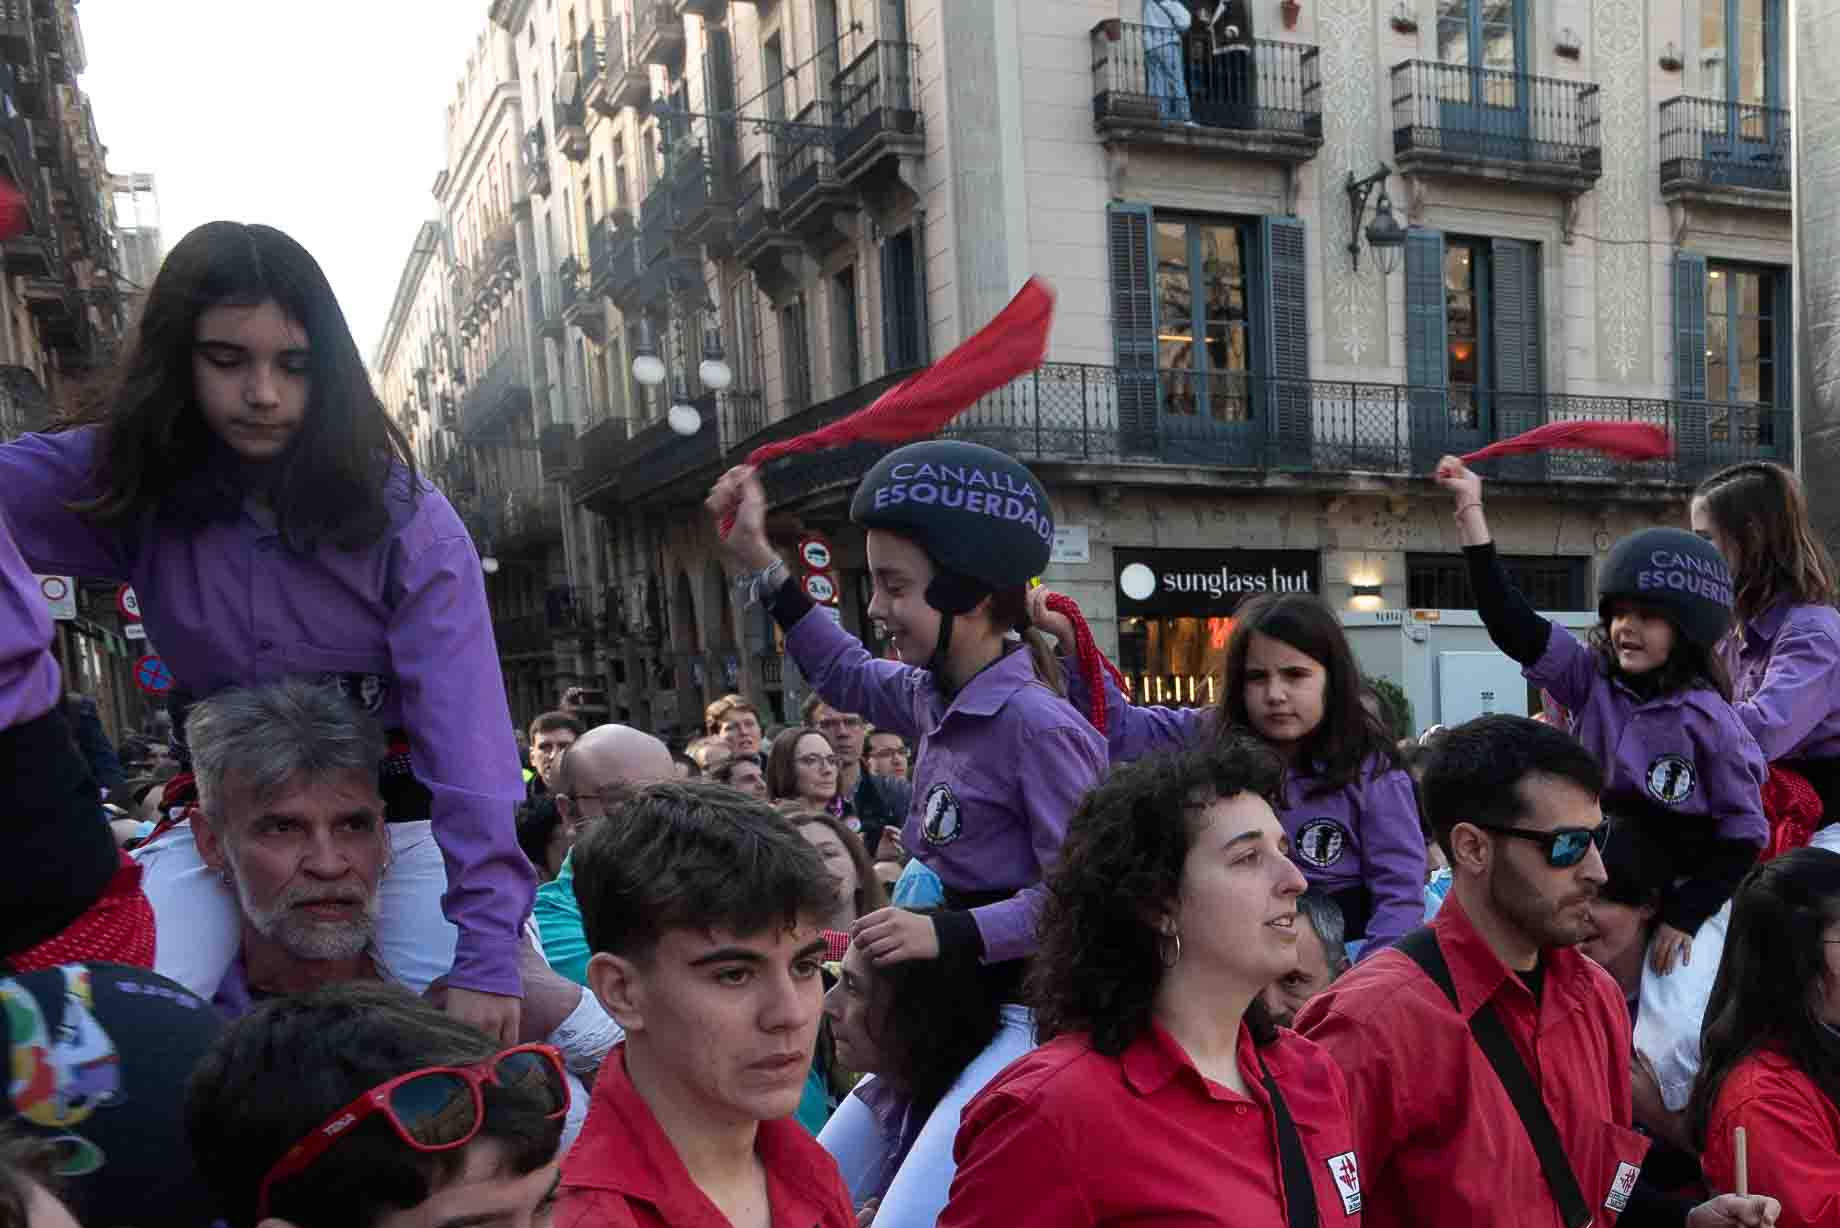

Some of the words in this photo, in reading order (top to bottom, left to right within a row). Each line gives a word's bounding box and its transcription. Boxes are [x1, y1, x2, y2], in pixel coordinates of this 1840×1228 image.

[890, 463, 1041, 503] CANALLA
[1162, 566, 1267, 599] sunglass
[1271, 567, 1311, 593] hut
